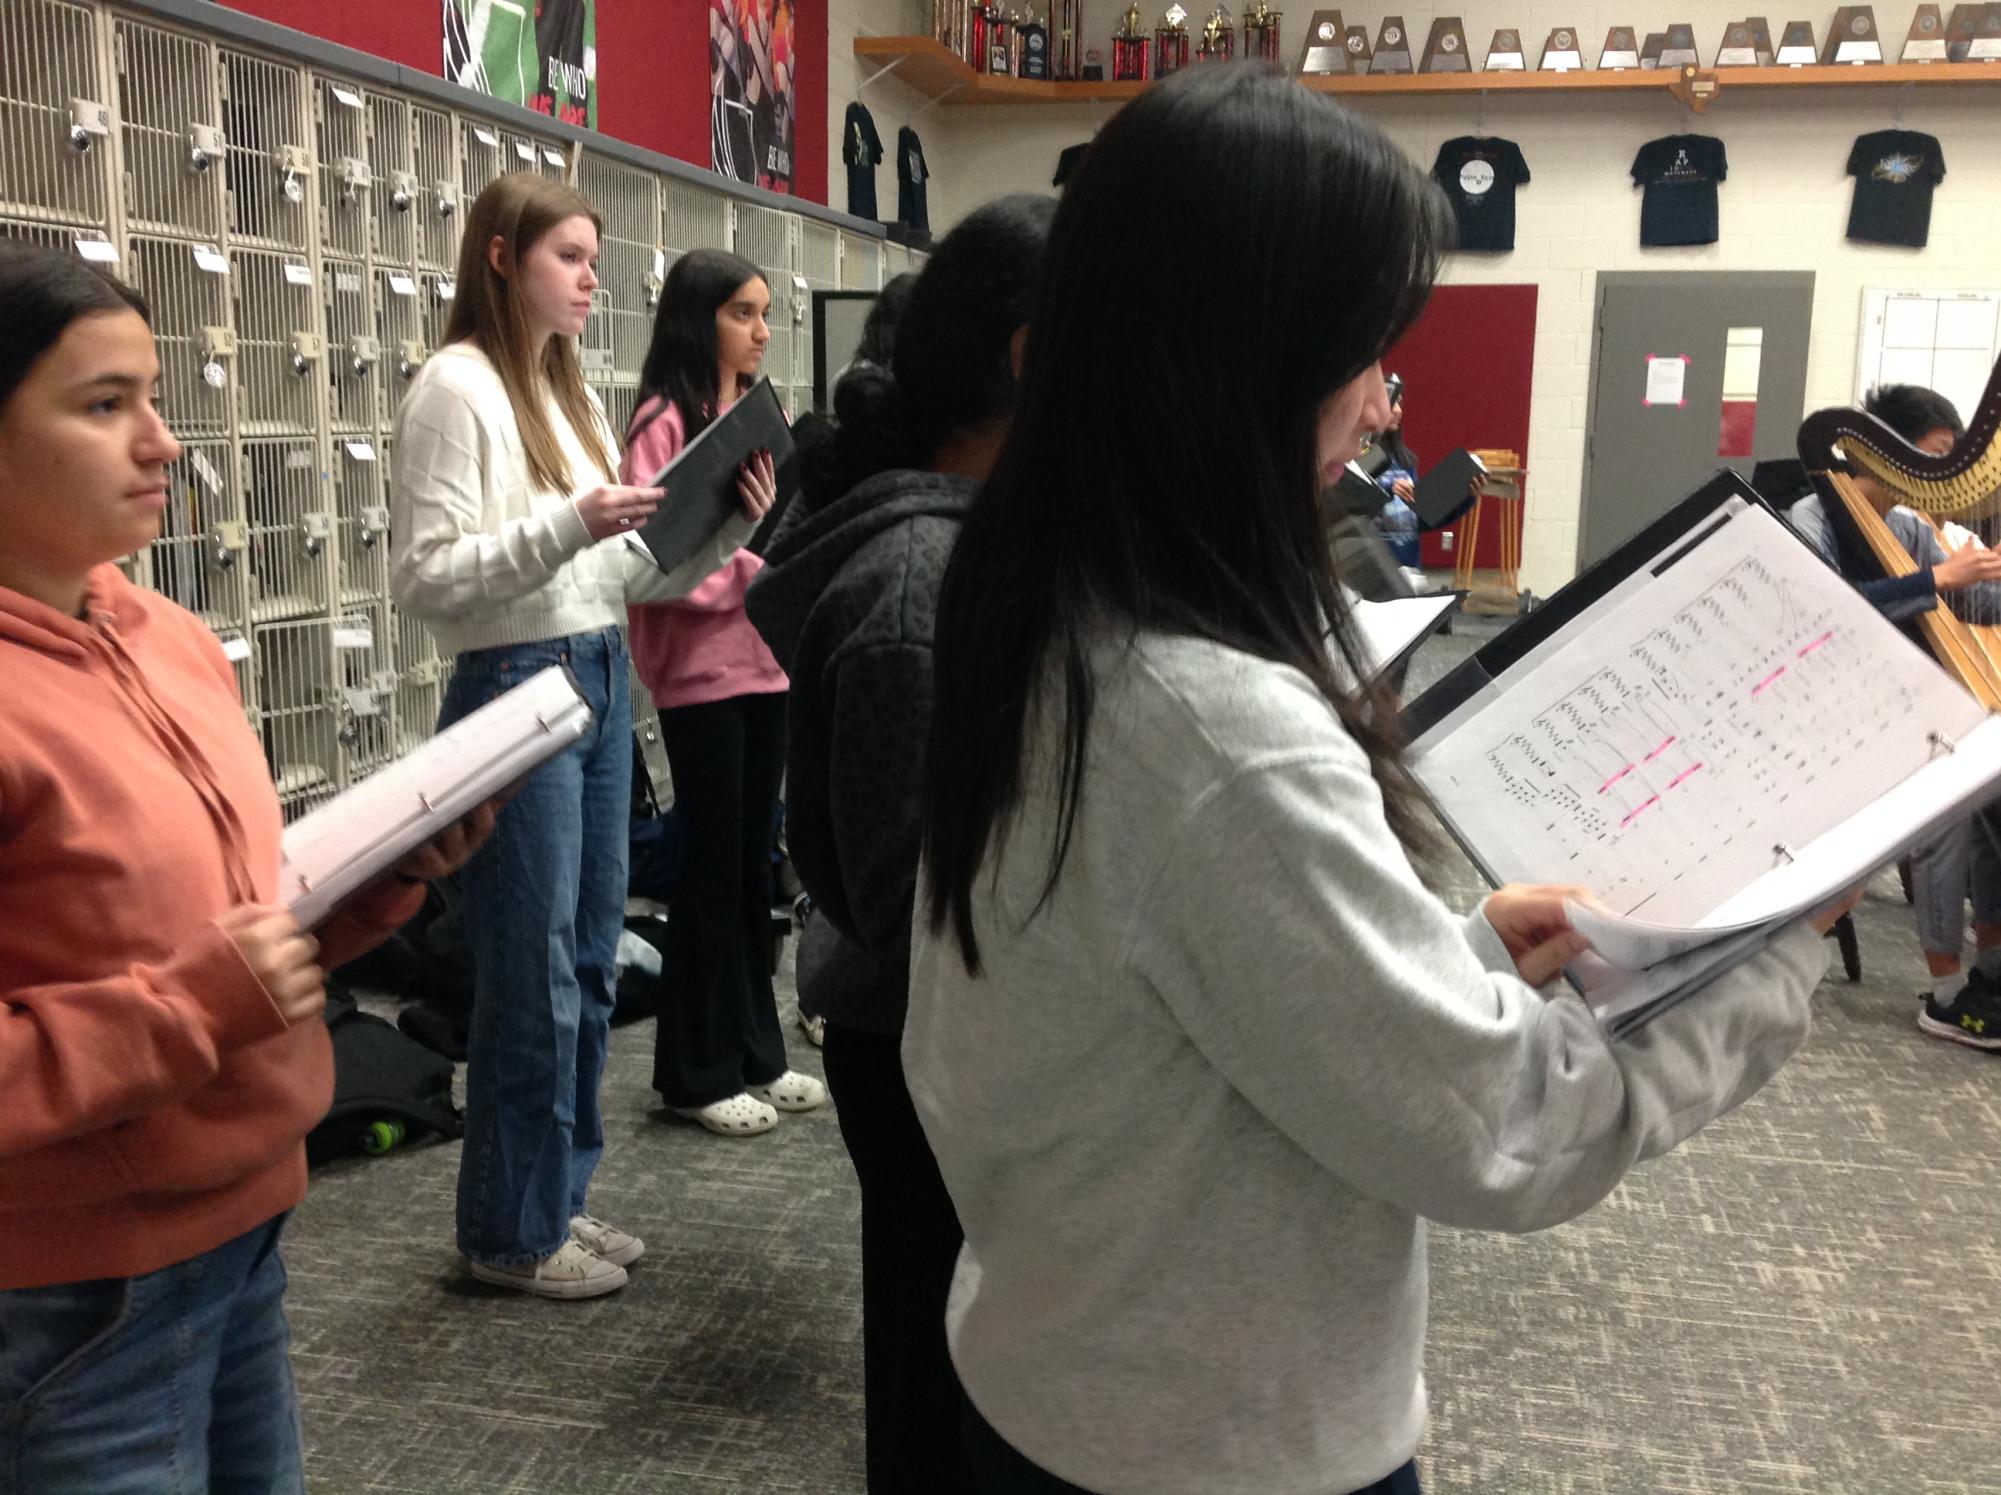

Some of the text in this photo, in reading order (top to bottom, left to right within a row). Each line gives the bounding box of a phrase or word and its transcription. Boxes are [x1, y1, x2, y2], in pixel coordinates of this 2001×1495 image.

[548, 56, 586, 100] BE WHO
[767, 145, 790, 177] BE WHO
